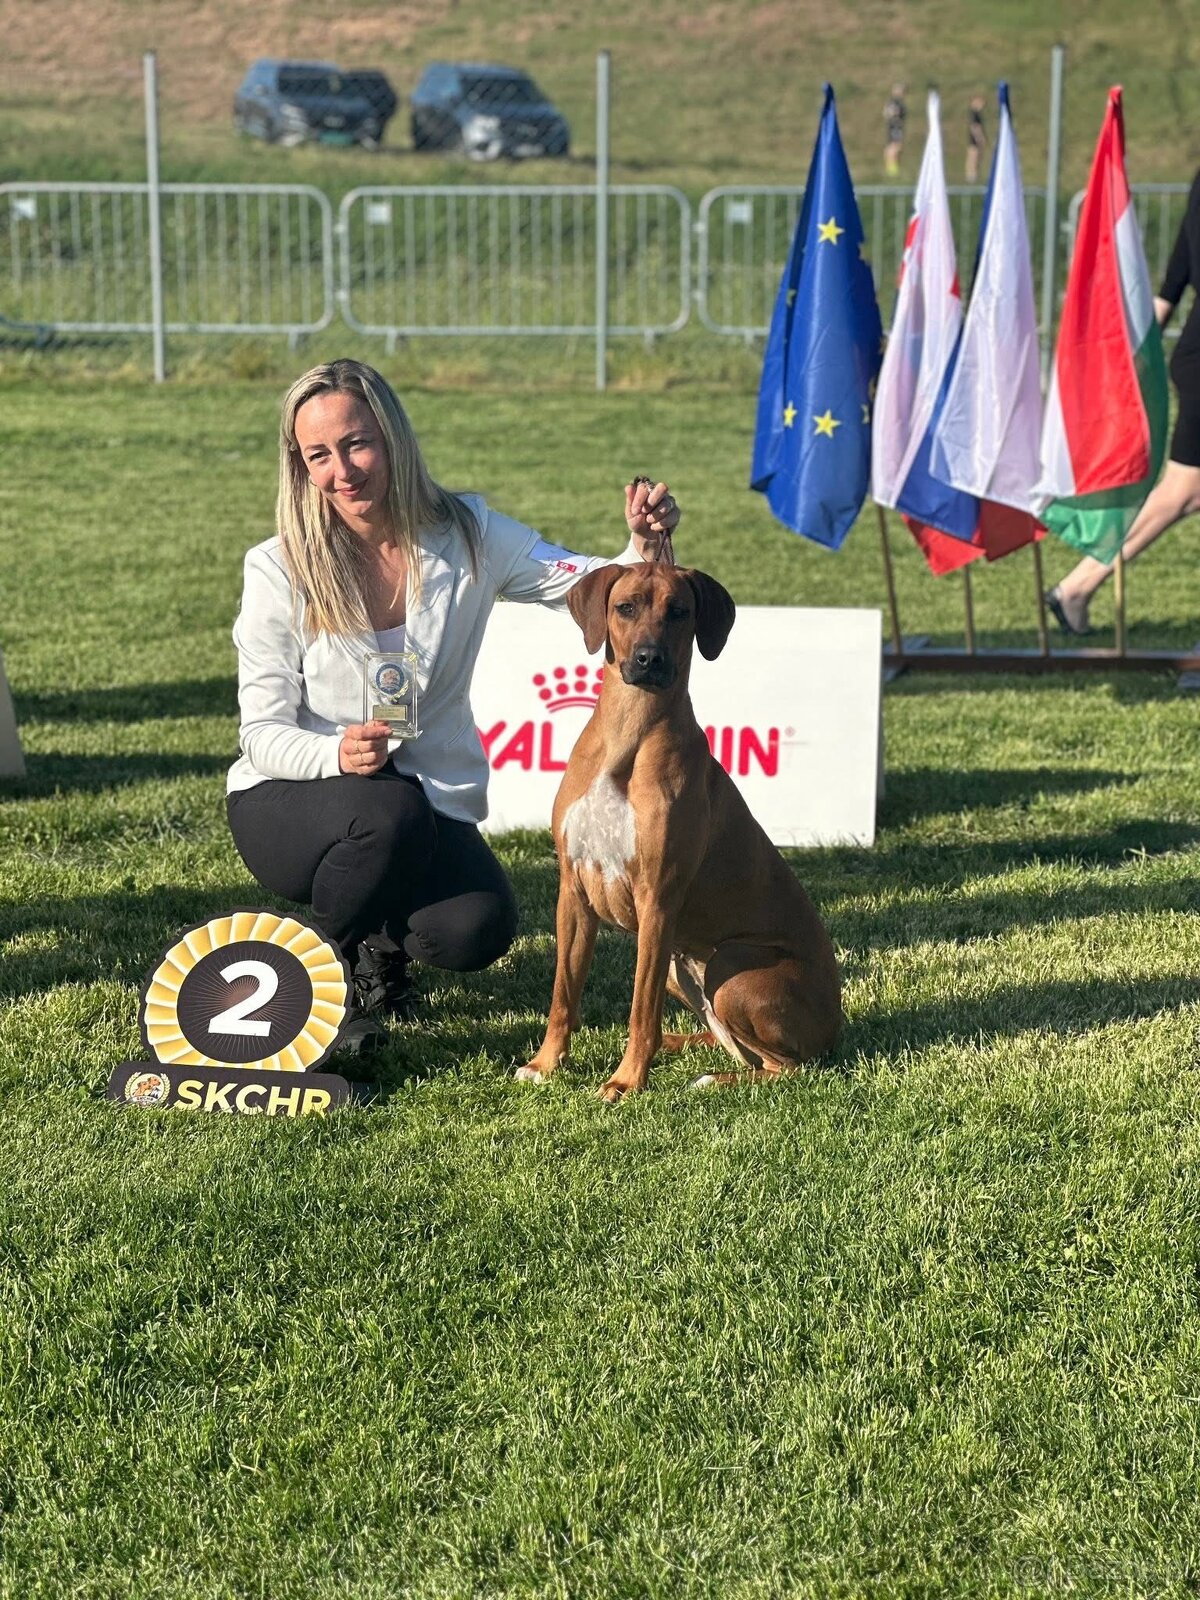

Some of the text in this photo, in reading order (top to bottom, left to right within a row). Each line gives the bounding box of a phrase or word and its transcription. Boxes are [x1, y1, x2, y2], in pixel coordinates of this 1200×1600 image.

[476, 720, 569, 771] YAL
[208, 960, 279, 1037] 2
[173, 1079, 332, 1118] SKCHR
